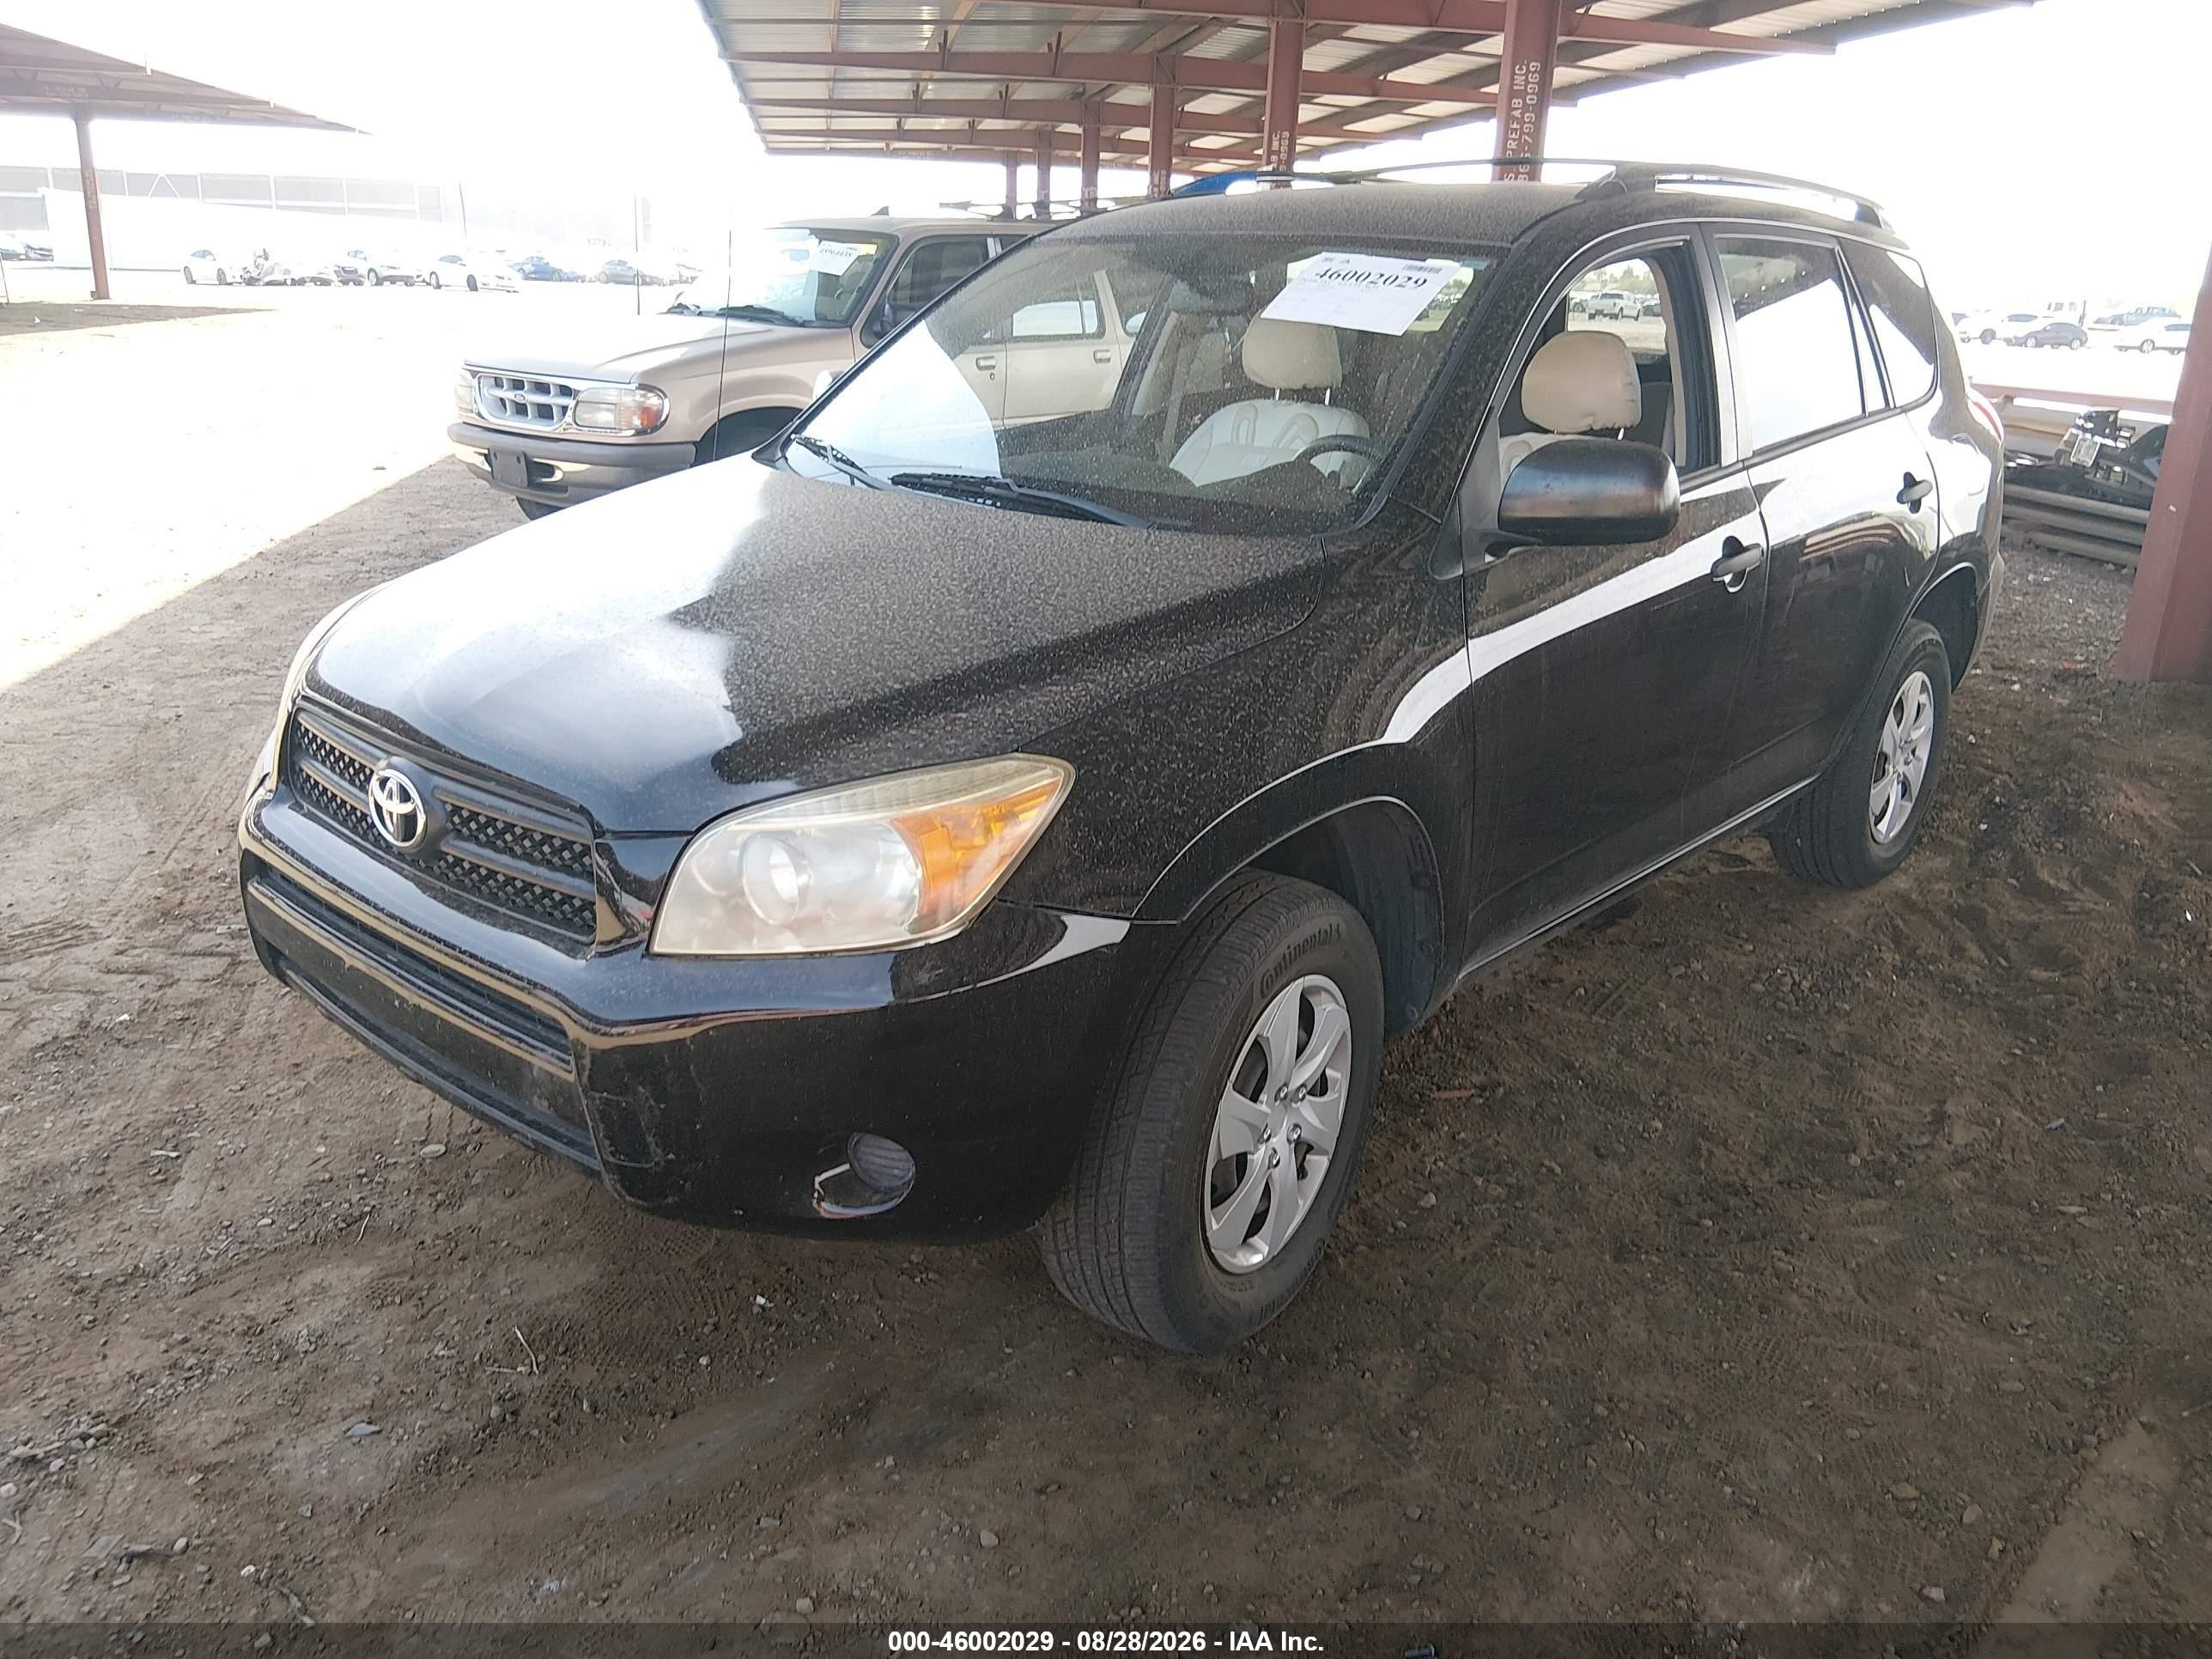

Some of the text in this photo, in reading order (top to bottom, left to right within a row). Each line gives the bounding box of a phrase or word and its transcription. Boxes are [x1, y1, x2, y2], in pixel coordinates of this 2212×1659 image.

[1513, 59, 1527, 90] INC.
[1505, 98, 1523, 159] PREFAB
[1314, 267, 1428, 289] 46002029
